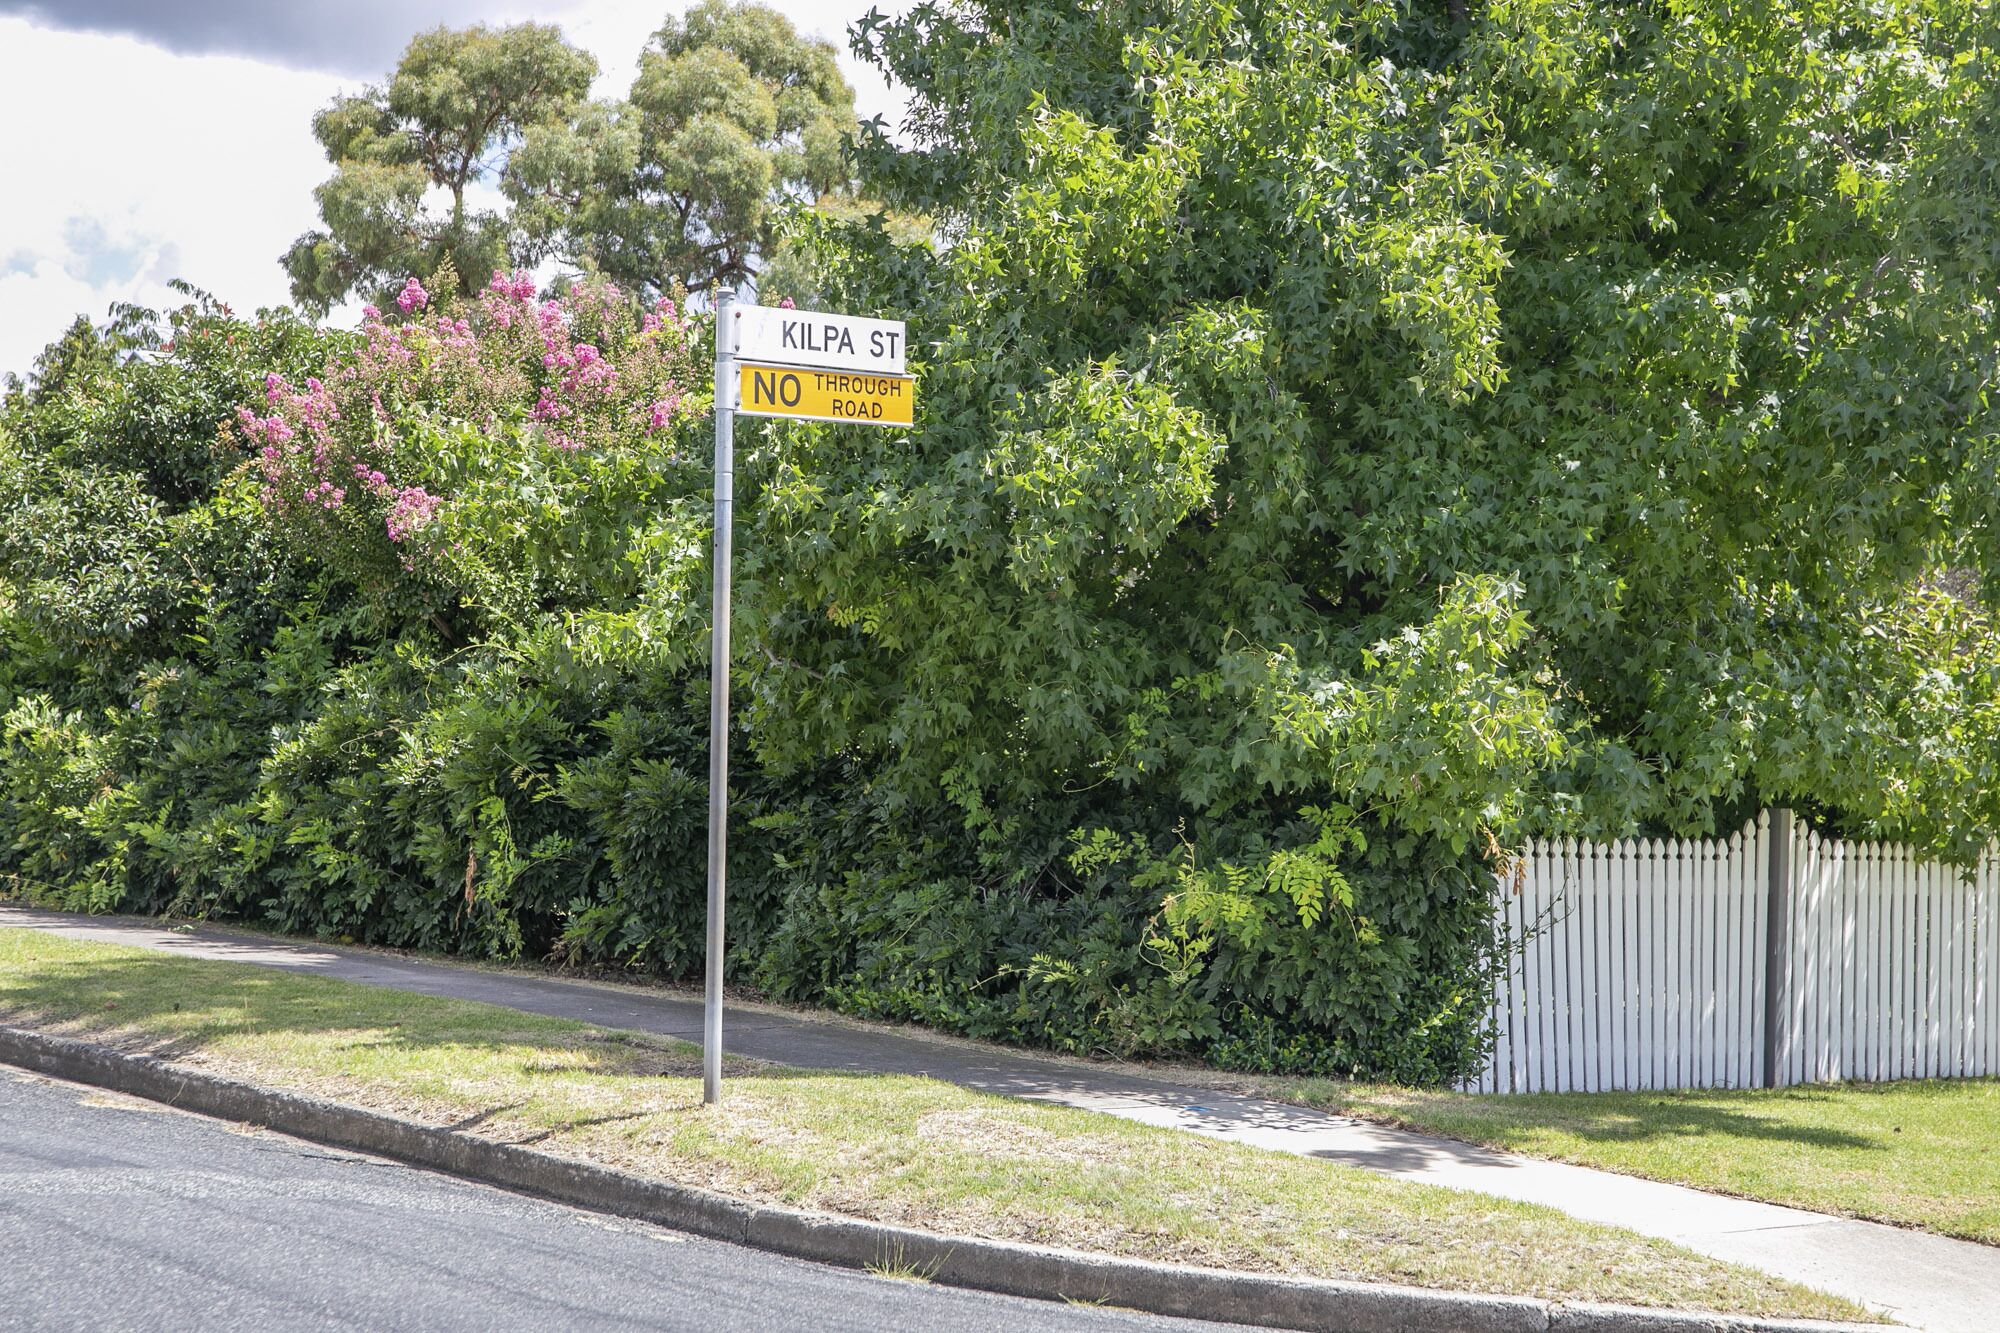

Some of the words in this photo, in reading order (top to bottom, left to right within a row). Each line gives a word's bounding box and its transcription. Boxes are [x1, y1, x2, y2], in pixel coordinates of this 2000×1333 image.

[782, 320, 855, 355] KILPA
[870, 330, 900, 359] ST
[754, 371, 801, 407] NO
[814, 374, 901, 397] THROUGH
[832, 399, 883, 418] ROAD
